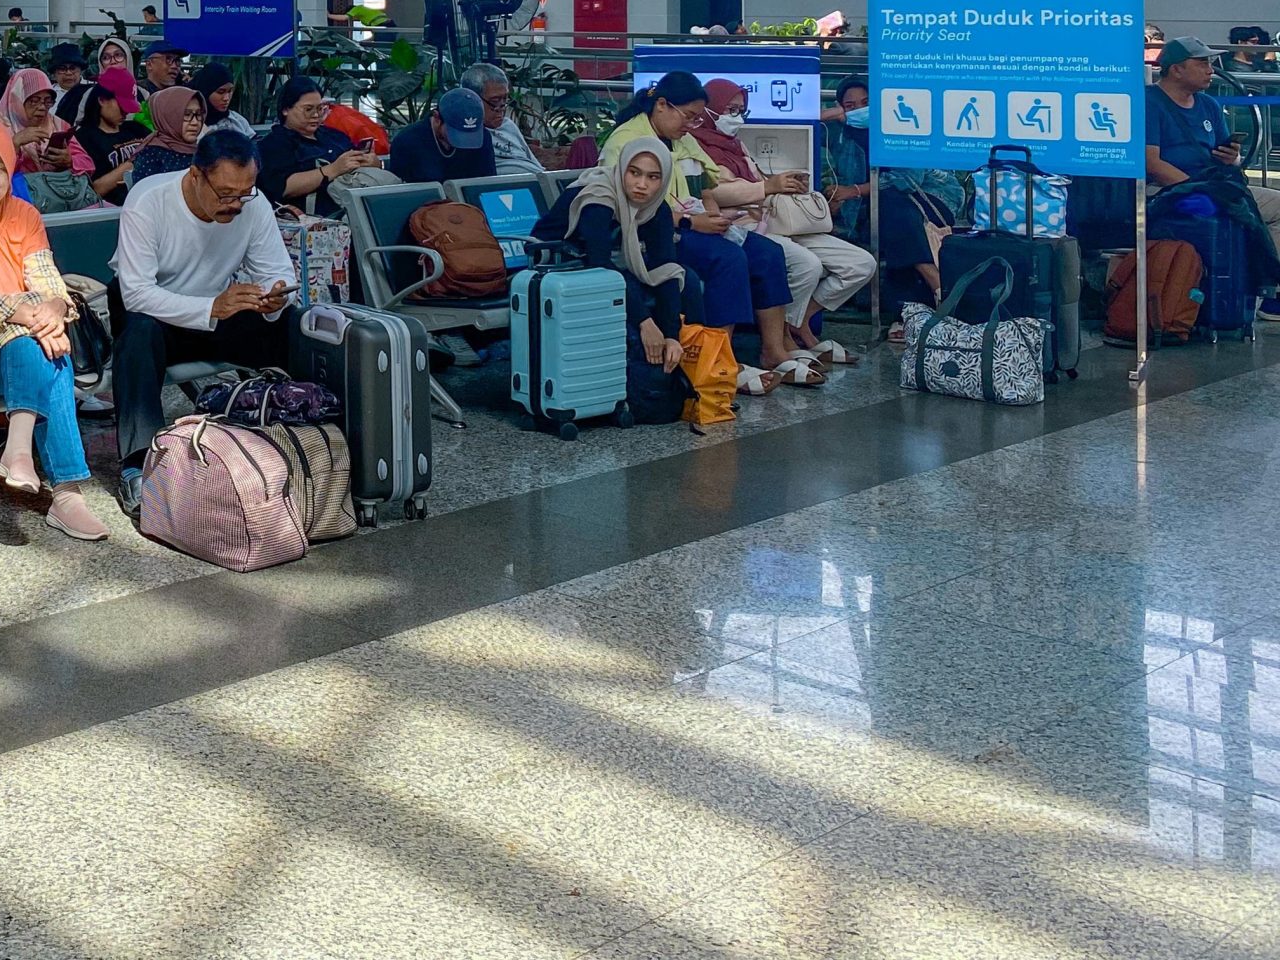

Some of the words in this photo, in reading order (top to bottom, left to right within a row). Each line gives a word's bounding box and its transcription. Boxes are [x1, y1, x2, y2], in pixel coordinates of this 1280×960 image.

[204, 6, 225, 14] Intercity
[226, 5, 240, 13] Train
[240, 6, 260, 14] Waiting
[261, 5, 277, 13] Room
[881, 9, 958, 28] Tempat
[964, 9, 1034, 26] Duduk
[1040, 9, 1134, 26] Prioritas
[881, 29, 933, 43] Priority
[937, 29, 972, 41] Seat
[881, 52, 912, 61] Tempat
[956, 53, 987, 61] khusus
[988, 54, 1008, 63] bagi
[1010, 55, 1064, 63] penumpang
[1066, 56, 1089, 64] yang
[935, 62, 990, 71] kenyamanan
[1022, 64, 1056, 72] dengan
[1093, 64, 1131, 72] berikut:
[1080, 145, 1126, 154] Penumpang
[1079, 151, 1109, 159] dengan
